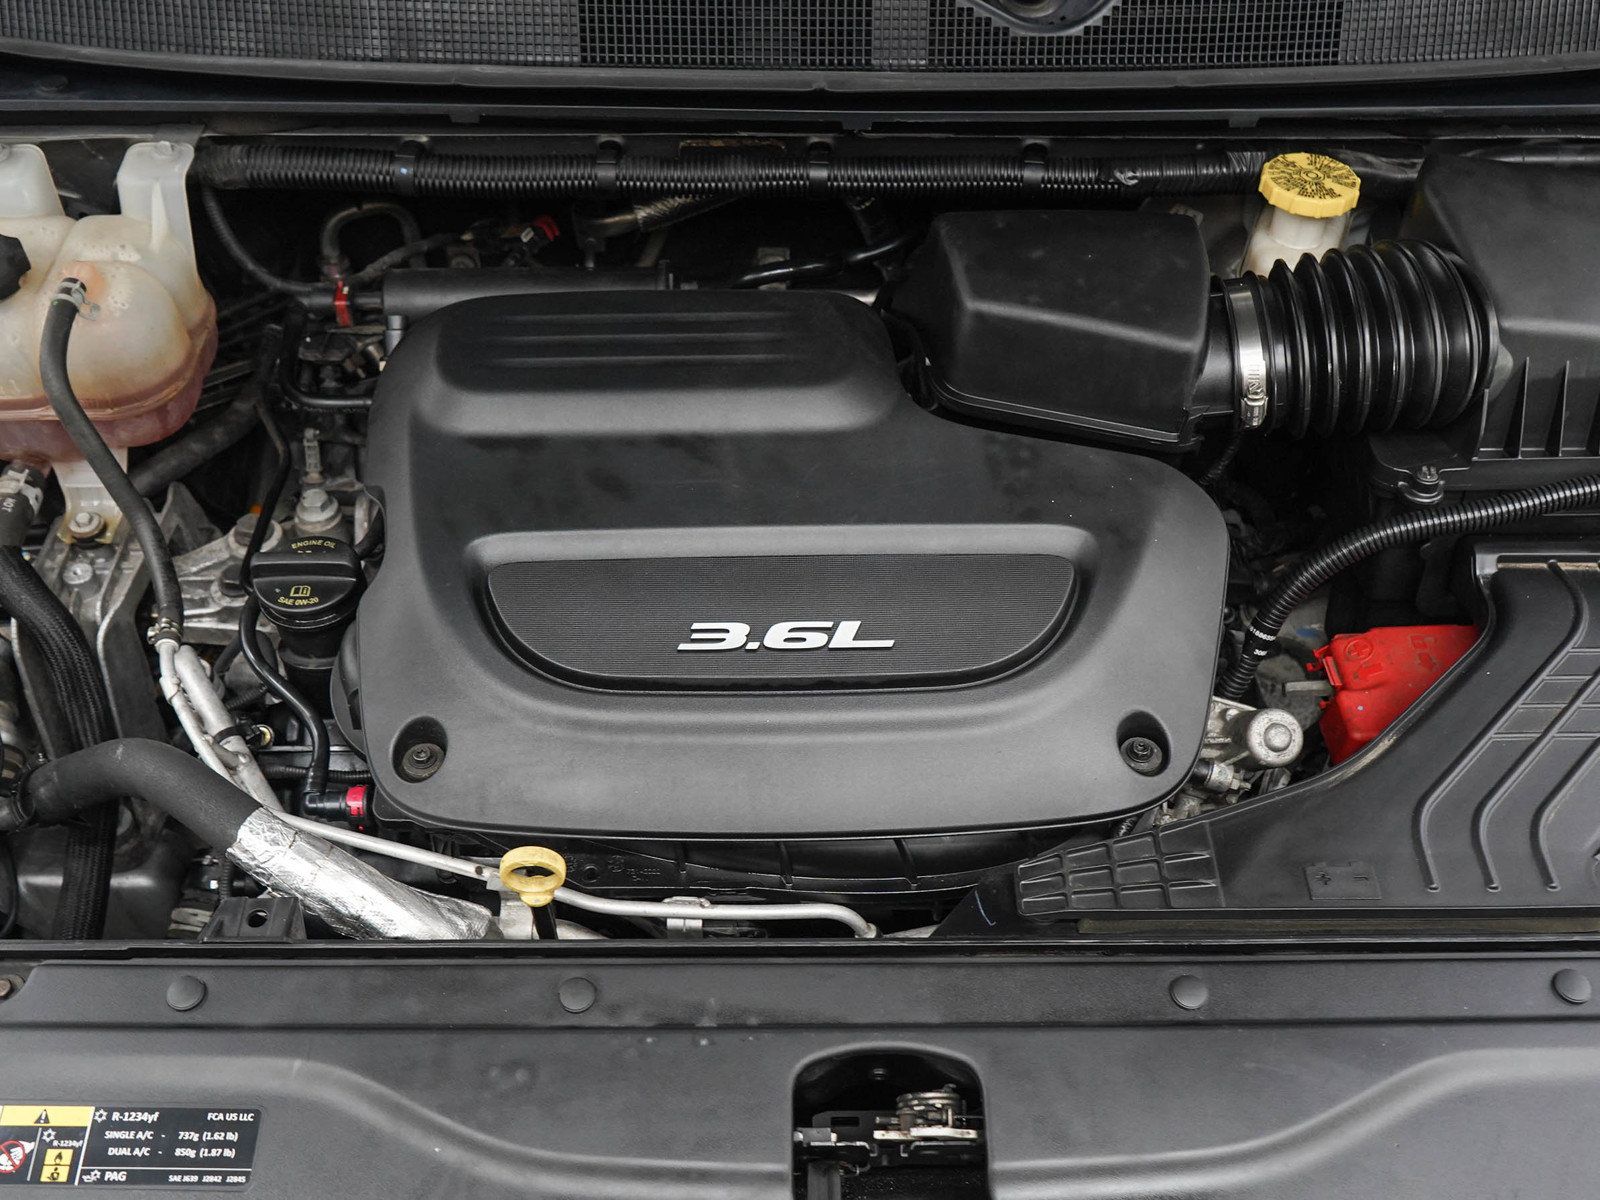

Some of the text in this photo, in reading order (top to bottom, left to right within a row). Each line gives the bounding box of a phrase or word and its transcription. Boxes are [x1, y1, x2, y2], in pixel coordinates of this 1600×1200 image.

[291, 540, 336, 549] ENGINE OIL
[277, 596, 319, 606] SAE 0W-20
[677, 620, 895, 650] 3.6L
[112, 1111, 160, 1123] R-1234yf
[207, 1112, 255, 1121] FCA US LLC
[104, 1130, 136, 1139] SINGLE
[136, 1130, 154, 1140] A/C
[178, 1131, 199, 1141] 737g
[202, 1131, 225, 1142] (1.62
[226, 1131, 239, 1142] lb)
[52, 1140, 84, 1148] R-1234yf
[107, 1147, 132, 1156] DUAL
[132, 1147, 151, 1157] A/C
[174, 1147, 197, 1158] 850g
[200, 1147, 222, 1158] (1.87
[222, 1148, 236, 1158] lb)
[104, 1171, 127, 1181] PAG
